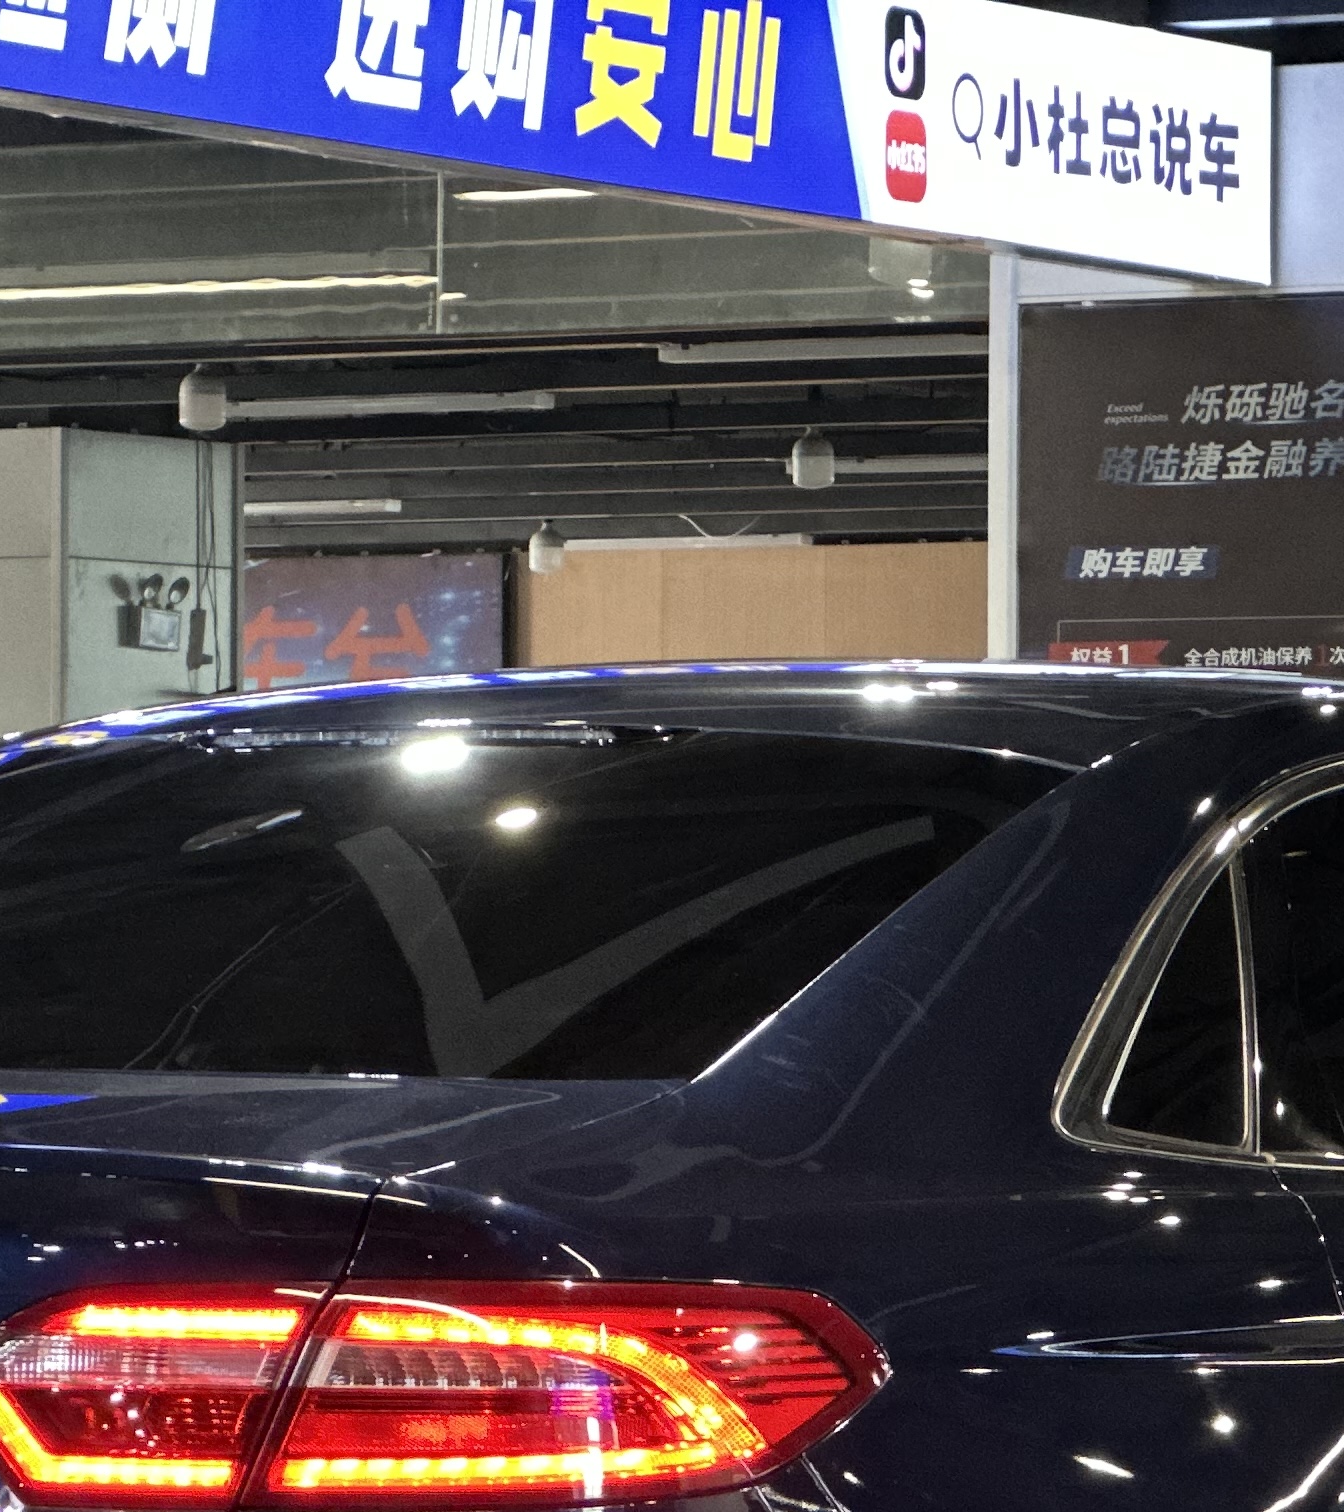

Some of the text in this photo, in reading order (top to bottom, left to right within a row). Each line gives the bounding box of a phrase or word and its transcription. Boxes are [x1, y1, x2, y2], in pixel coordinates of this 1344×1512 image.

[995, 74, 1241, 203] 小杜总说车
[1079, 546, 1208, 579] 购车即享
